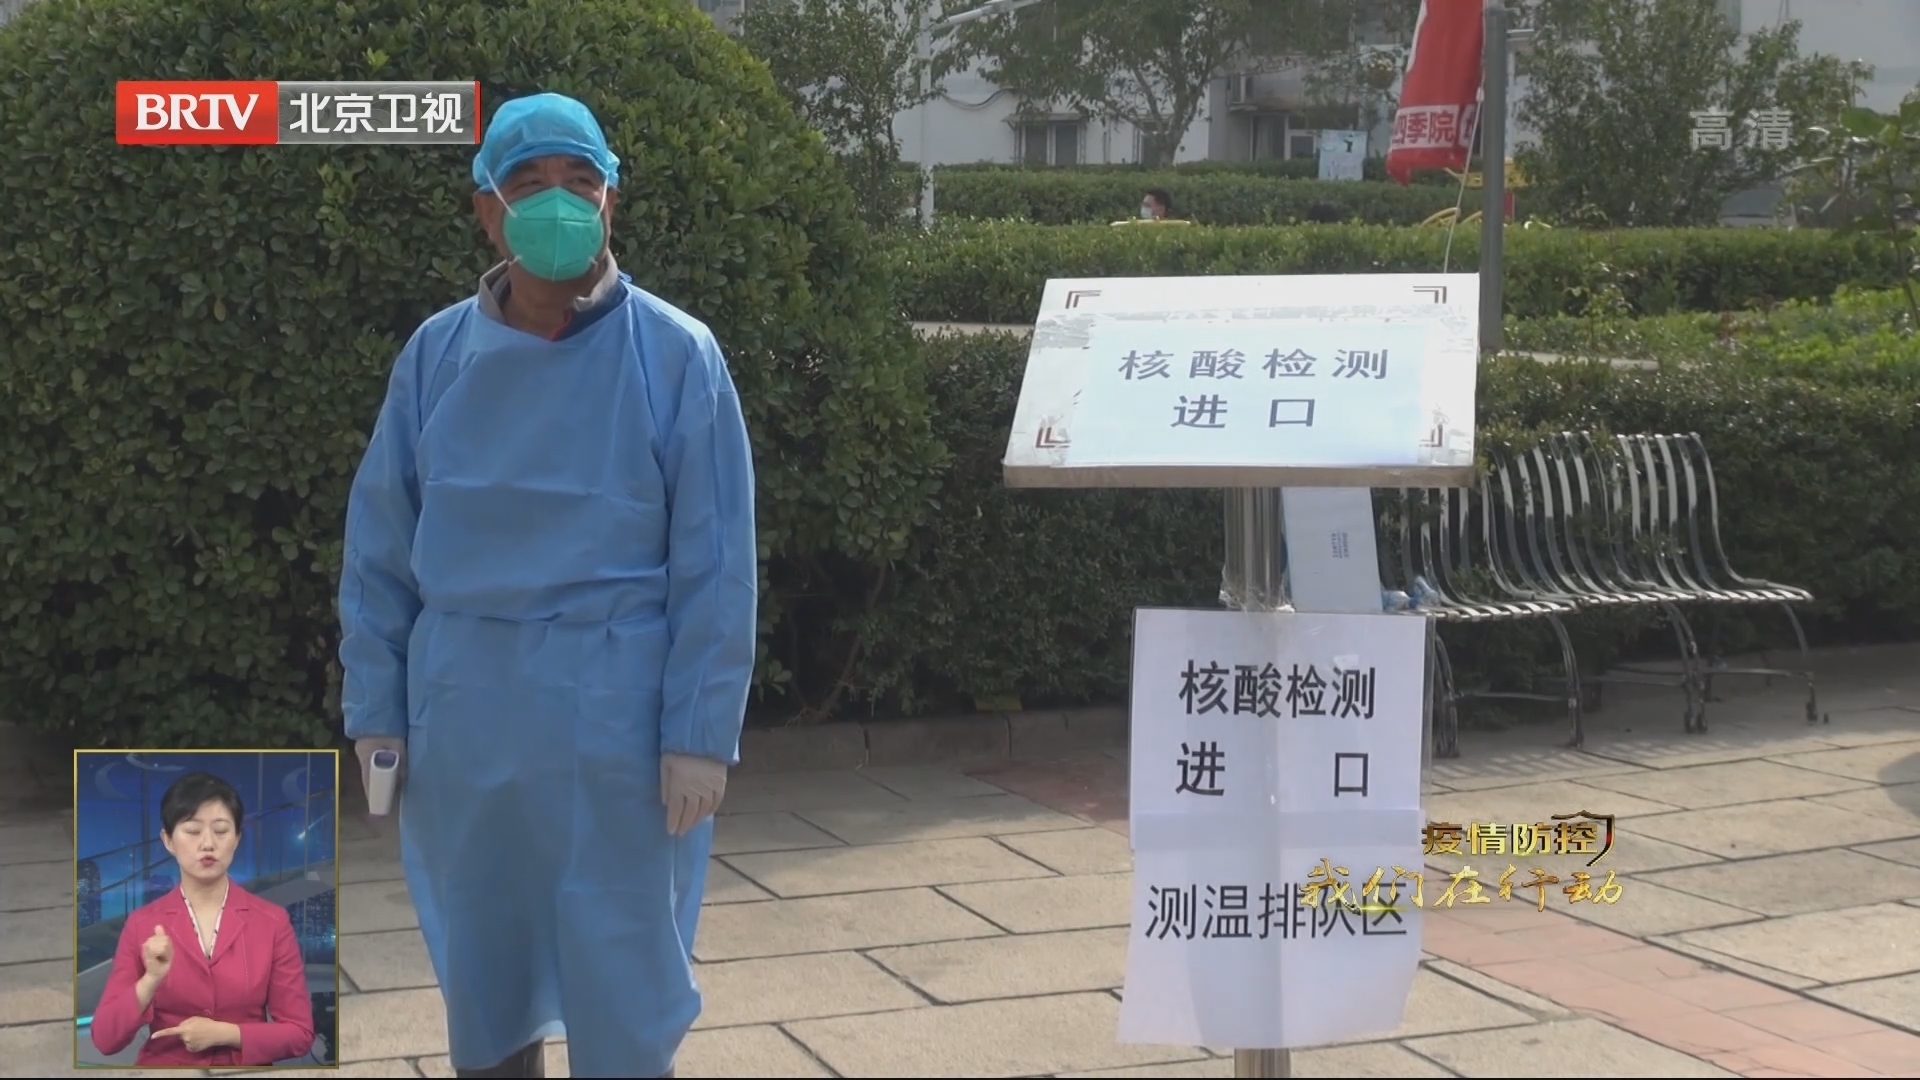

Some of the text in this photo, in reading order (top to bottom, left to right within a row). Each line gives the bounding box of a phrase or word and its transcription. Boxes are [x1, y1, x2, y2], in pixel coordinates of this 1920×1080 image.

[1393, 109, 1472, 144] 四季院
[1118, 348, 1389, 380] 核酸检测
[1171, 394, 1316, 429] 进口
[1178, 659, 1377, 719] 核酸检测
[1176, 741, 1370, 797] 进口
[1144, 883, 1408, 941] 测温排队区
